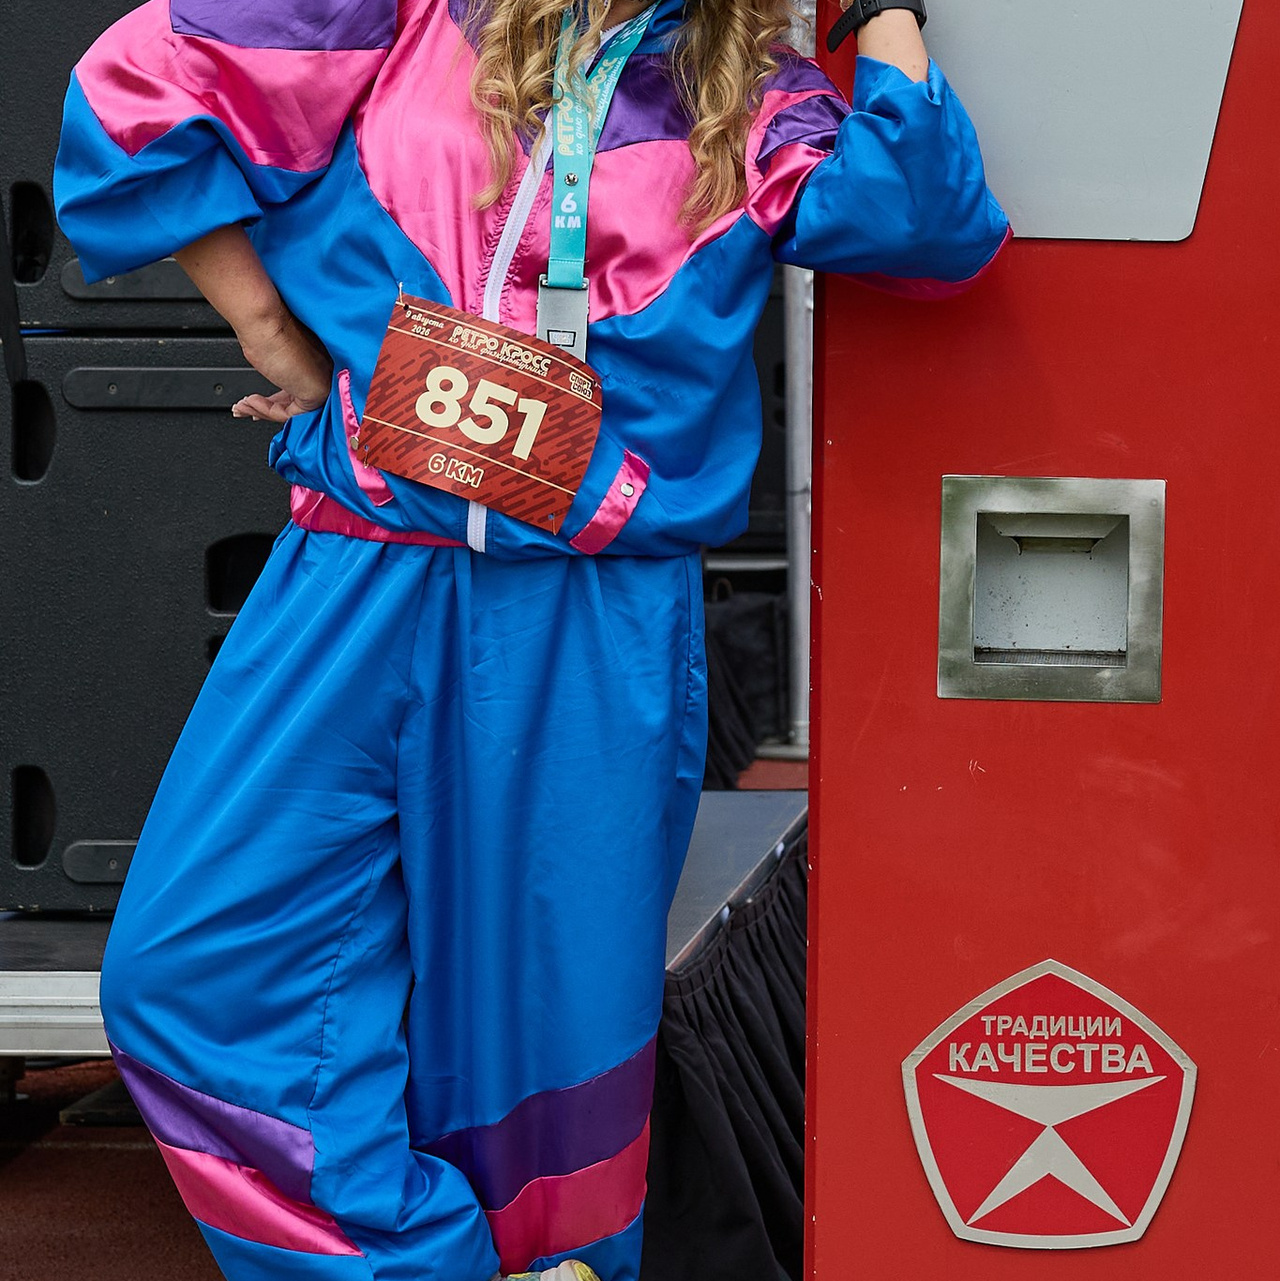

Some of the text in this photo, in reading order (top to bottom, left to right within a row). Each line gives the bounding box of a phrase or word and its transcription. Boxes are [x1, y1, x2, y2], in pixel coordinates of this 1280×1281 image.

[557, 97, 575, 156] РЕТРО
[575, 141, 584, 156] ко
[560, 192, 577, 214] 6
[554, 215, 581, 229] КМ
[405, 310, 444, 328] 9 августа
[411, 324, 430, 336] 2026
[452, 325, 551, 371] РЕТРО КРОСС
[571, 373, 590, 388] СПОРТ
[572, 384, 592, 398] СОЮЗ
[415, 366, 548, 461] 851
[428, 453, 484, 488] 6 КМ
[981, 1015, 1122, 1039] ТРАДИЦИИ
[948, 1042, 1154, 1073] КАЧЕСТВА
